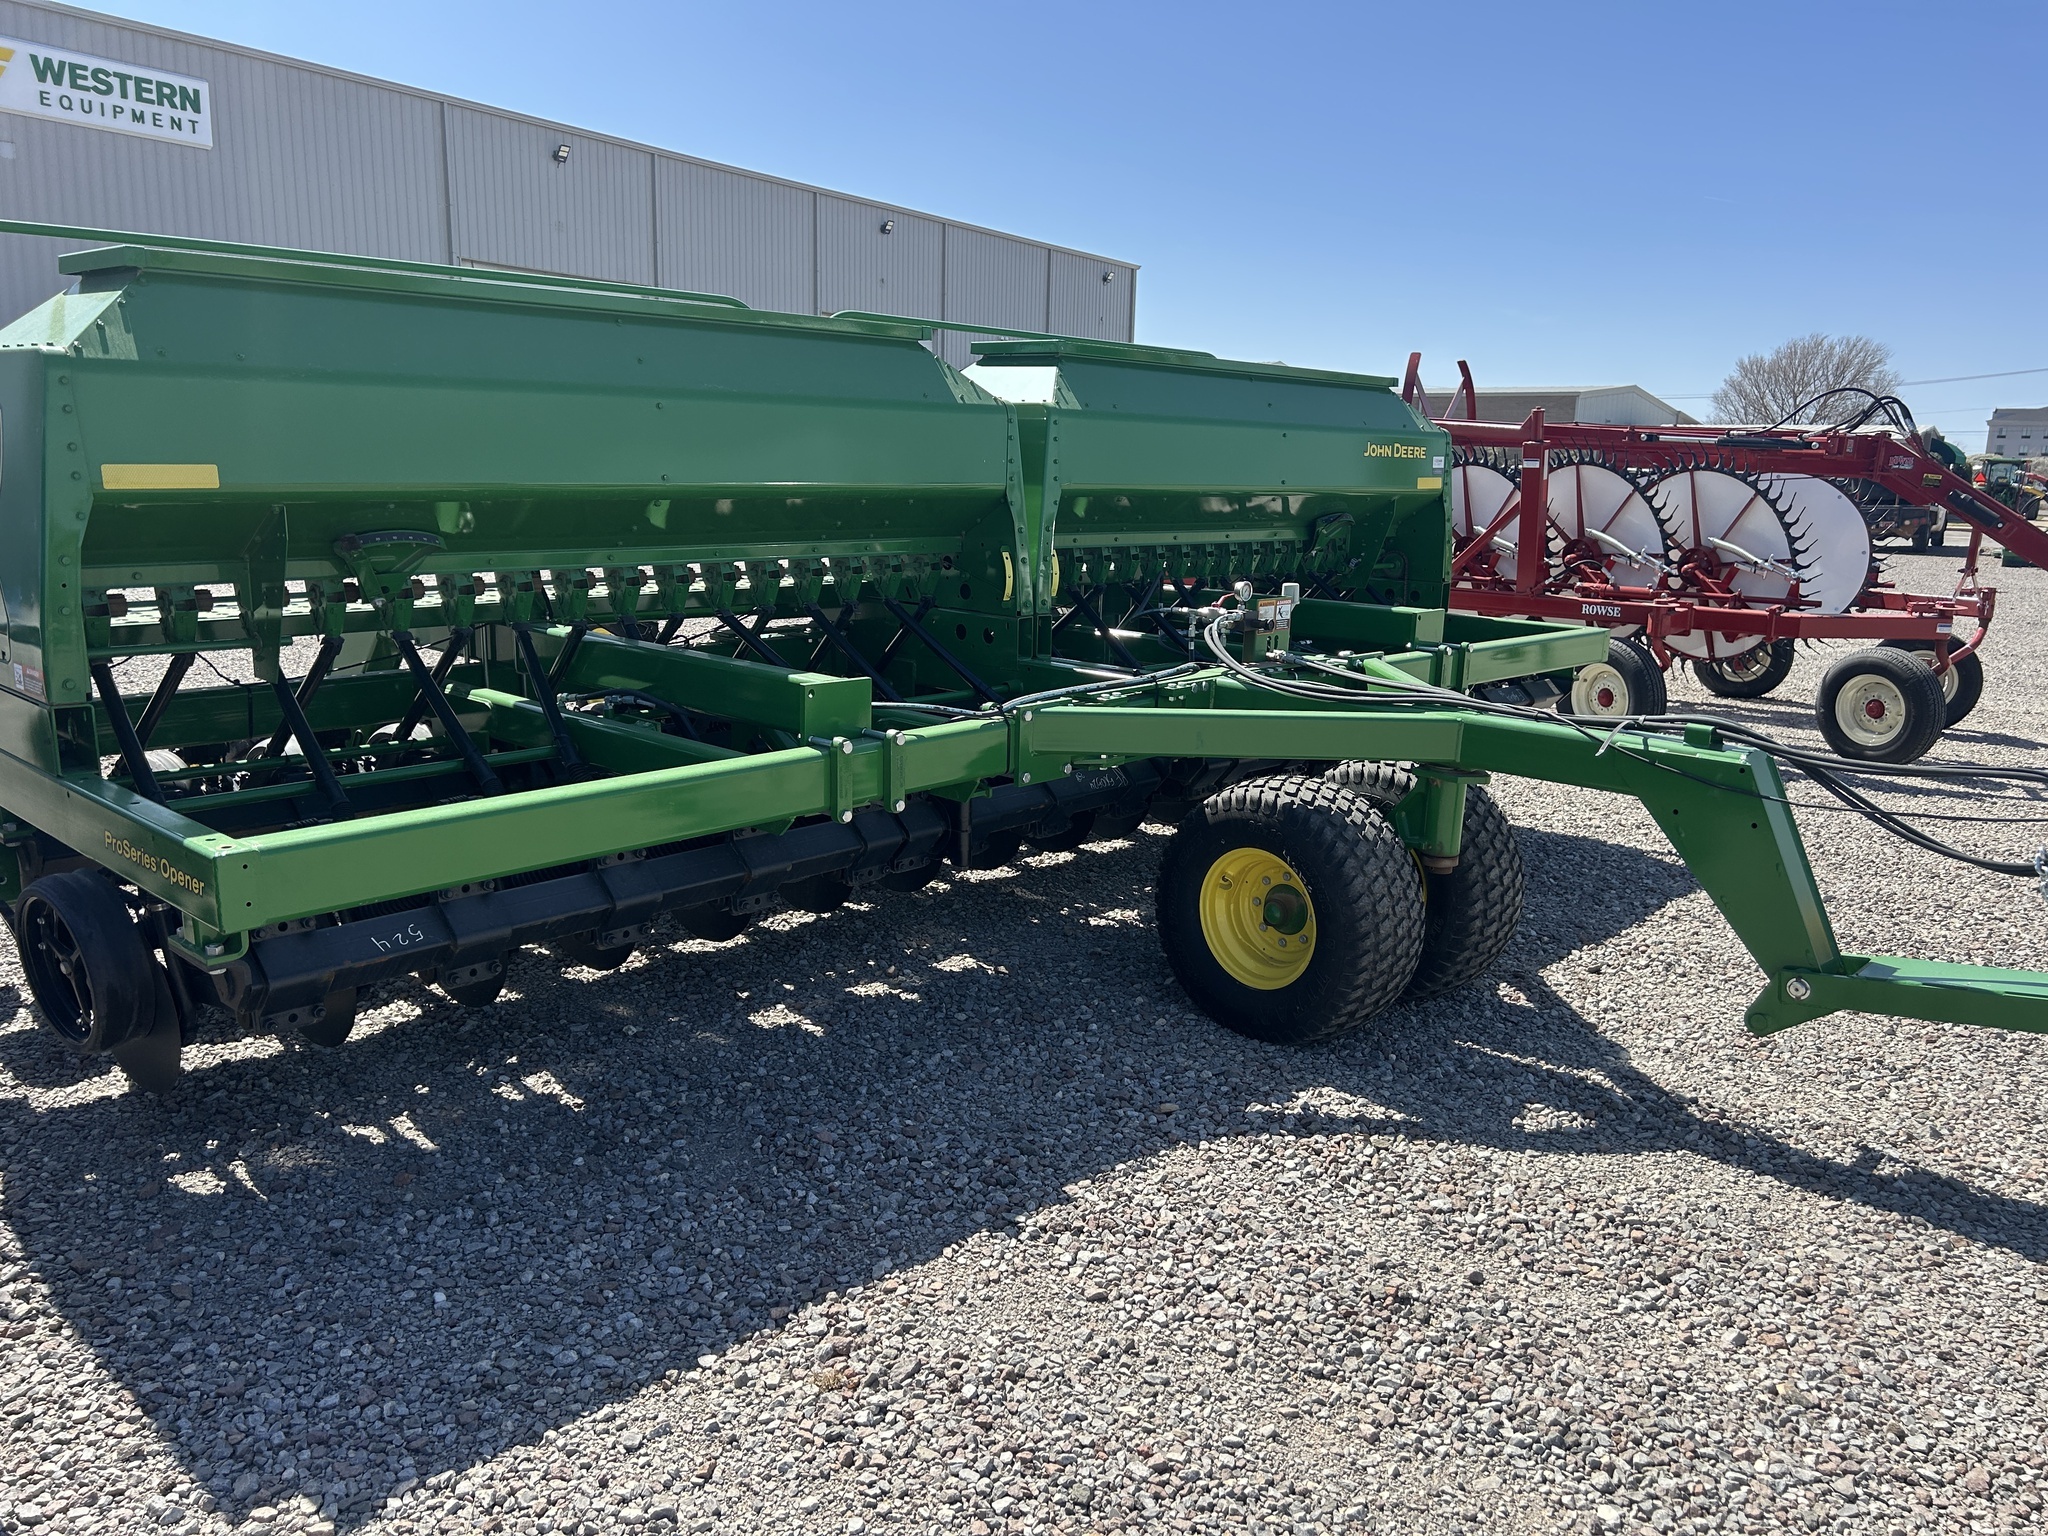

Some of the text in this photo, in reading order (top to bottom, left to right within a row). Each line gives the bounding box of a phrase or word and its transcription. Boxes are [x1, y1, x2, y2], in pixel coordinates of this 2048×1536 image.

[29, 53, 202, 115] WESTERN
[39, 90, 199, 135] EQUIPMENT
[1363, 441, 1427, 459] JOHN DEERE
[1581, 603, 1621, 618] ROWSE
[104, 830, 205, 896] ProSeries Opener
[370, 923, 424, 952] 524
